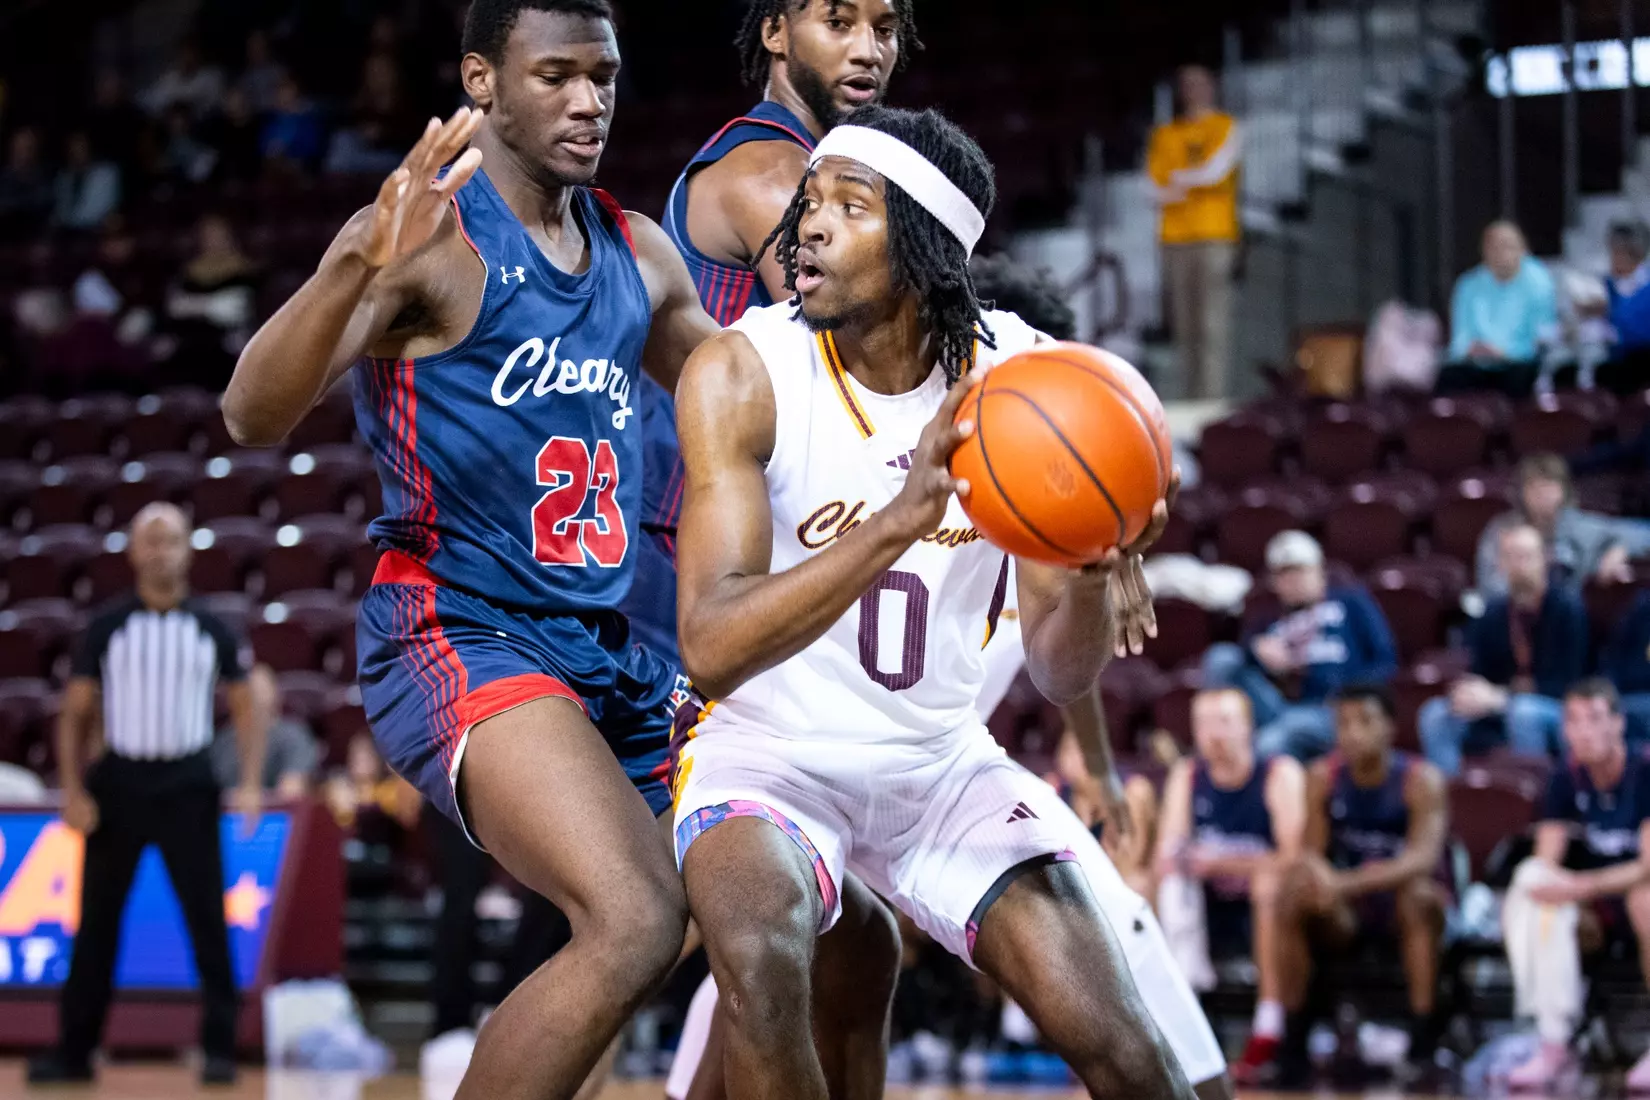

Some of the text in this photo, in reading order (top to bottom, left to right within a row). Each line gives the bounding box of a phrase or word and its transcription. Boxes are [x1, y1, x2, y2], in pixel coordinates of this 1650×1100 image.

[490, 336, 634, 430] Cleary
[530, 435, 628, 568] 23
[857, 569, 929, 692] 0
